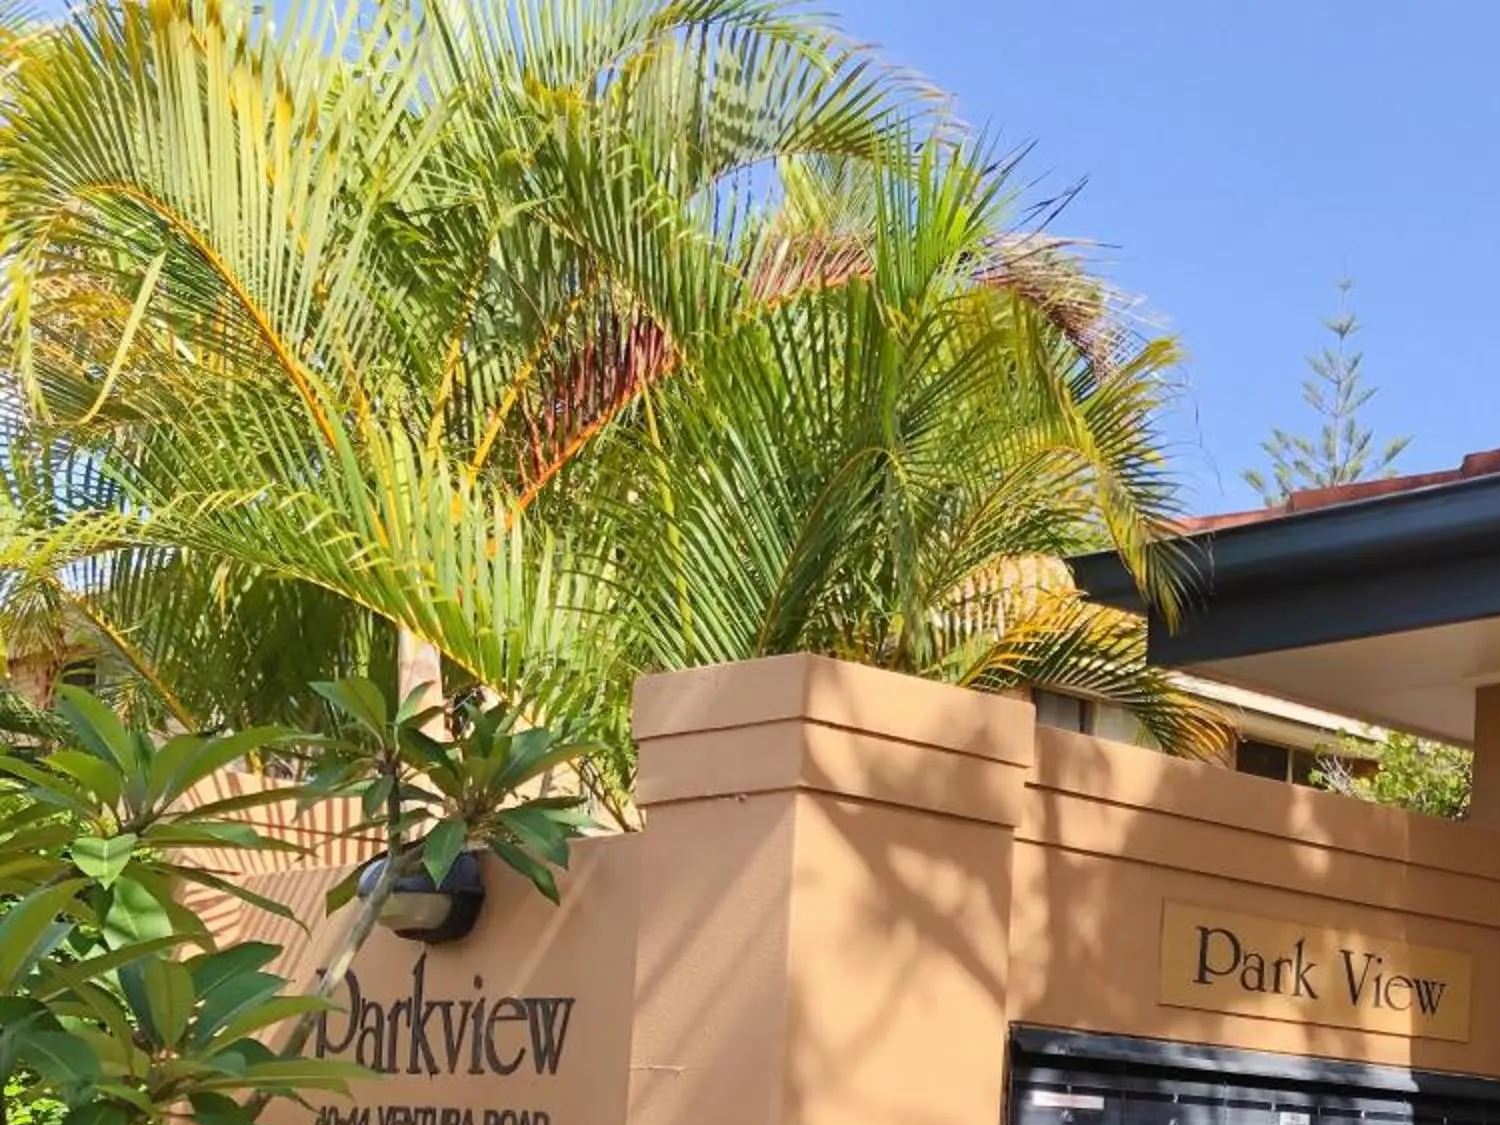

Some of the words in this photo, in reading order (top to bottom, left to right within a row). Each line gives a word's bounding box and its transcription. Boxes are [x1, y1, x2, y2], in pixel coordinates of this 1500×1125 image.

[315, 952, 576, 1077] Parkview
[1192, 925, 1318, 1000] Park
[1338, 949, 1447, 1018] View
